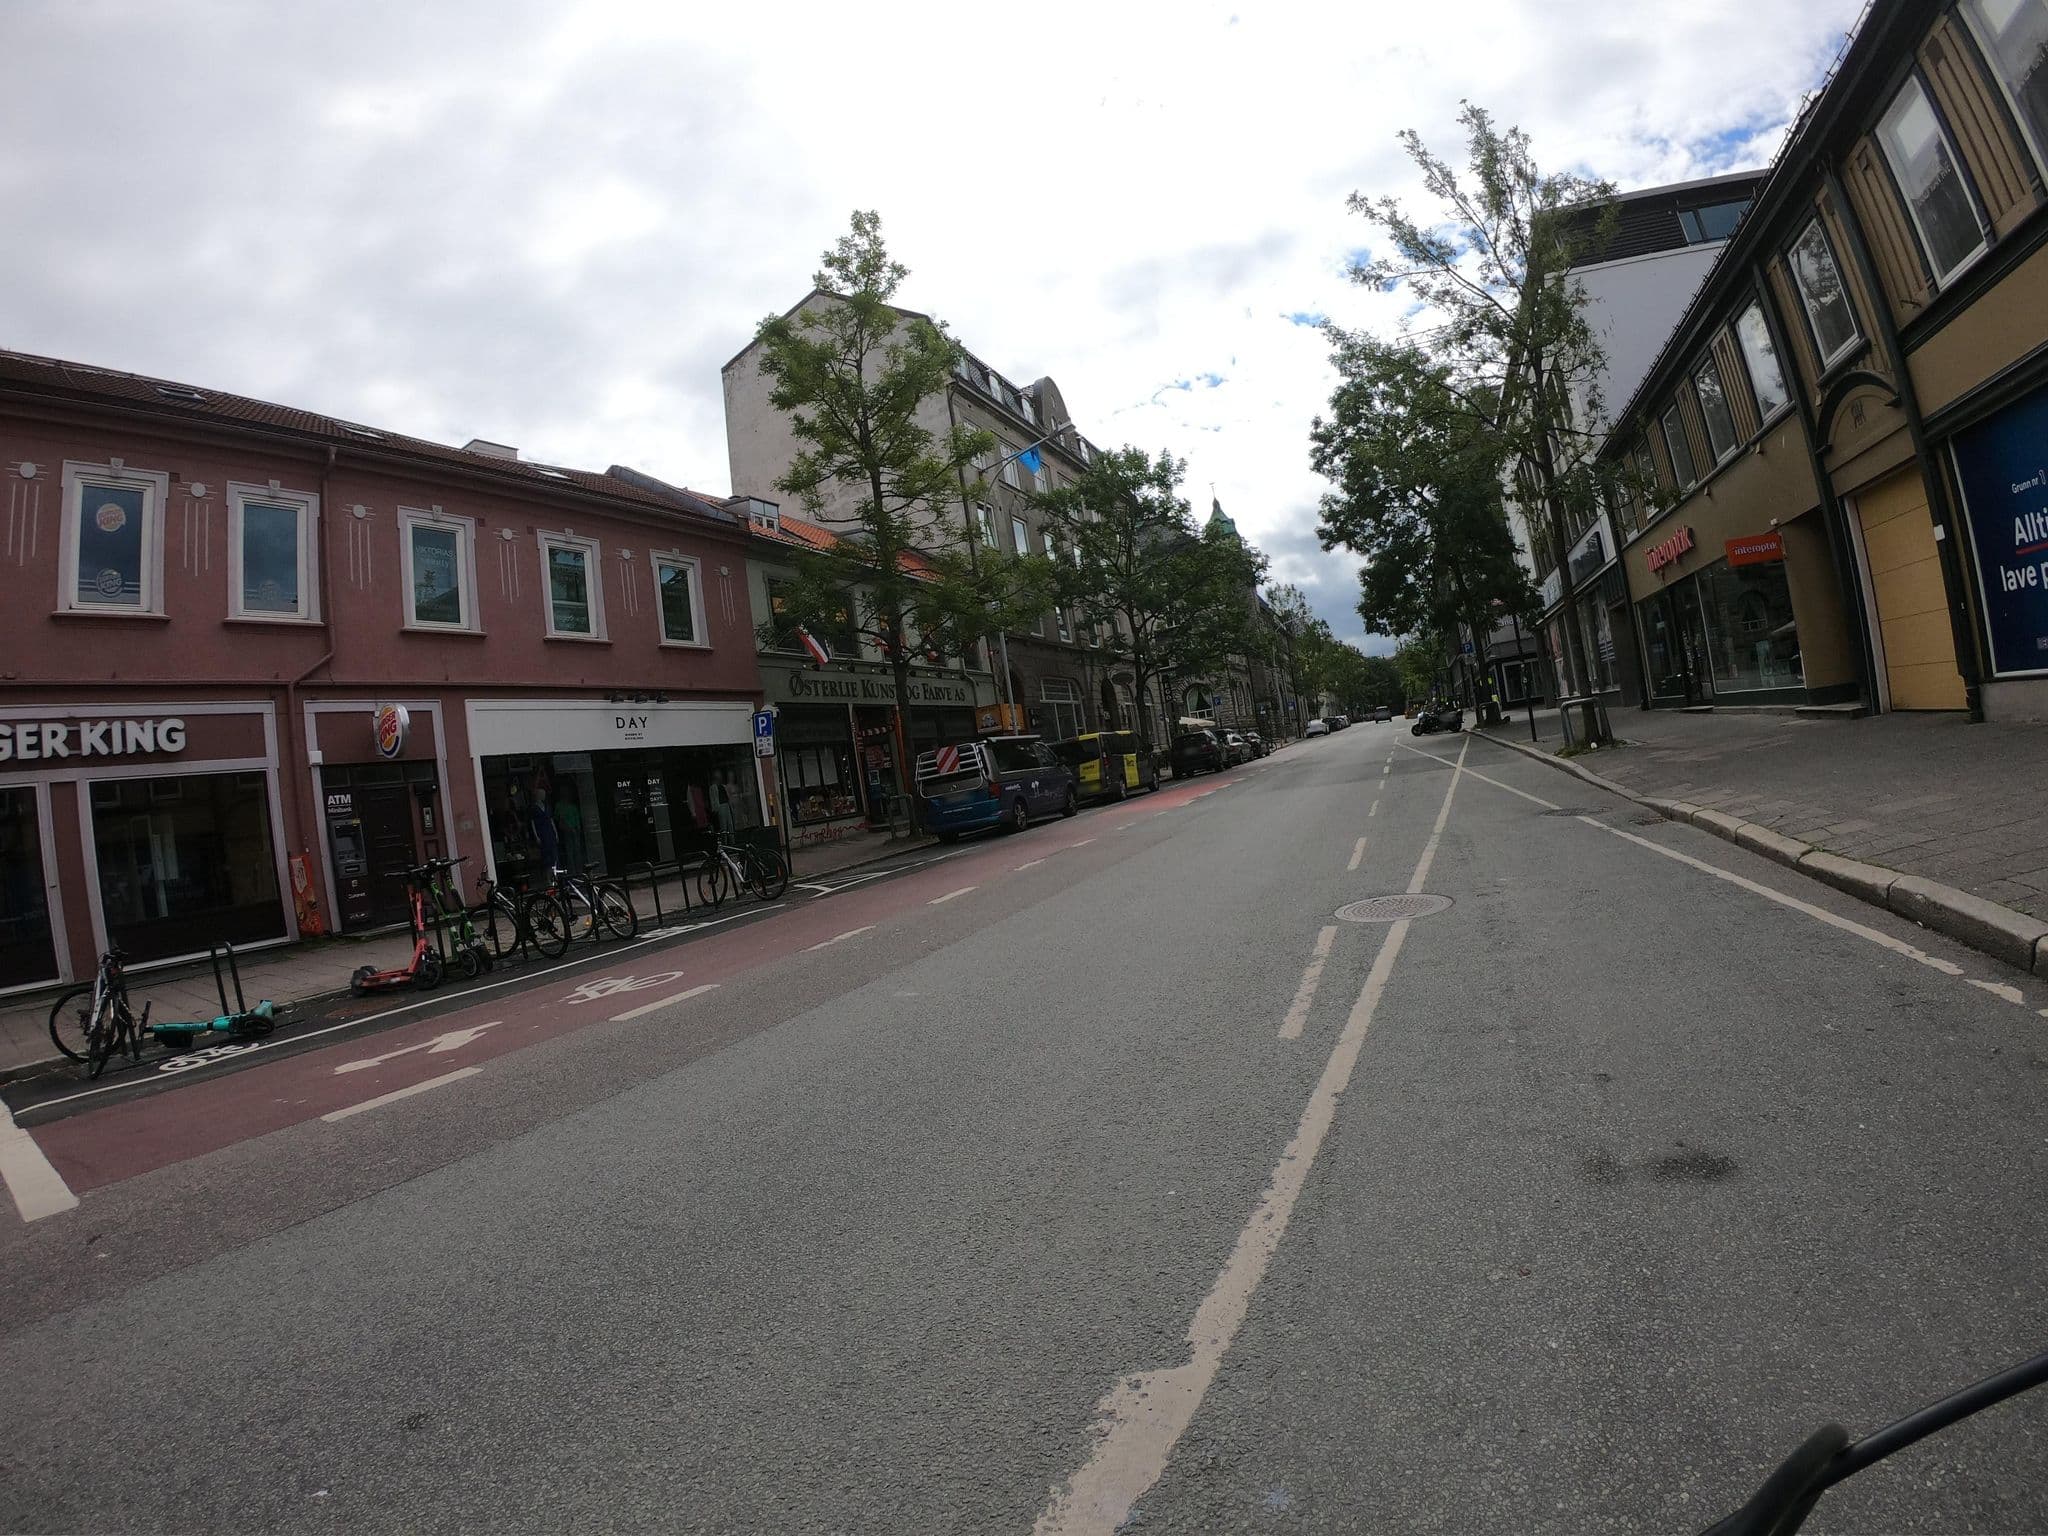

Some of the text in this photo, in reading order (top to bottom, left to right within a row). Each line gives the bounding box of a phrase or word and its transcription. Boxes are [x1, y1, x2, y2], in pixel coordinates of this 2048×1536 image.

[2011, 479, 2031, 493] Grunn
[1646, 524, 1693, 574] interoptik
[1734, 541, 1777, 556] interoptik
[2000, 563, 2038, 592] lave
[860, 679, 897, 699] KUNS
[921, 682, 952, 701] FARVE
[953, 687, 966, 702] AS
[616, 717, 648, 729] DAY
[758, 716, 768, 735] P
[80, 719, 187, 756] KING
[328, 794, 352, 805] ATM
